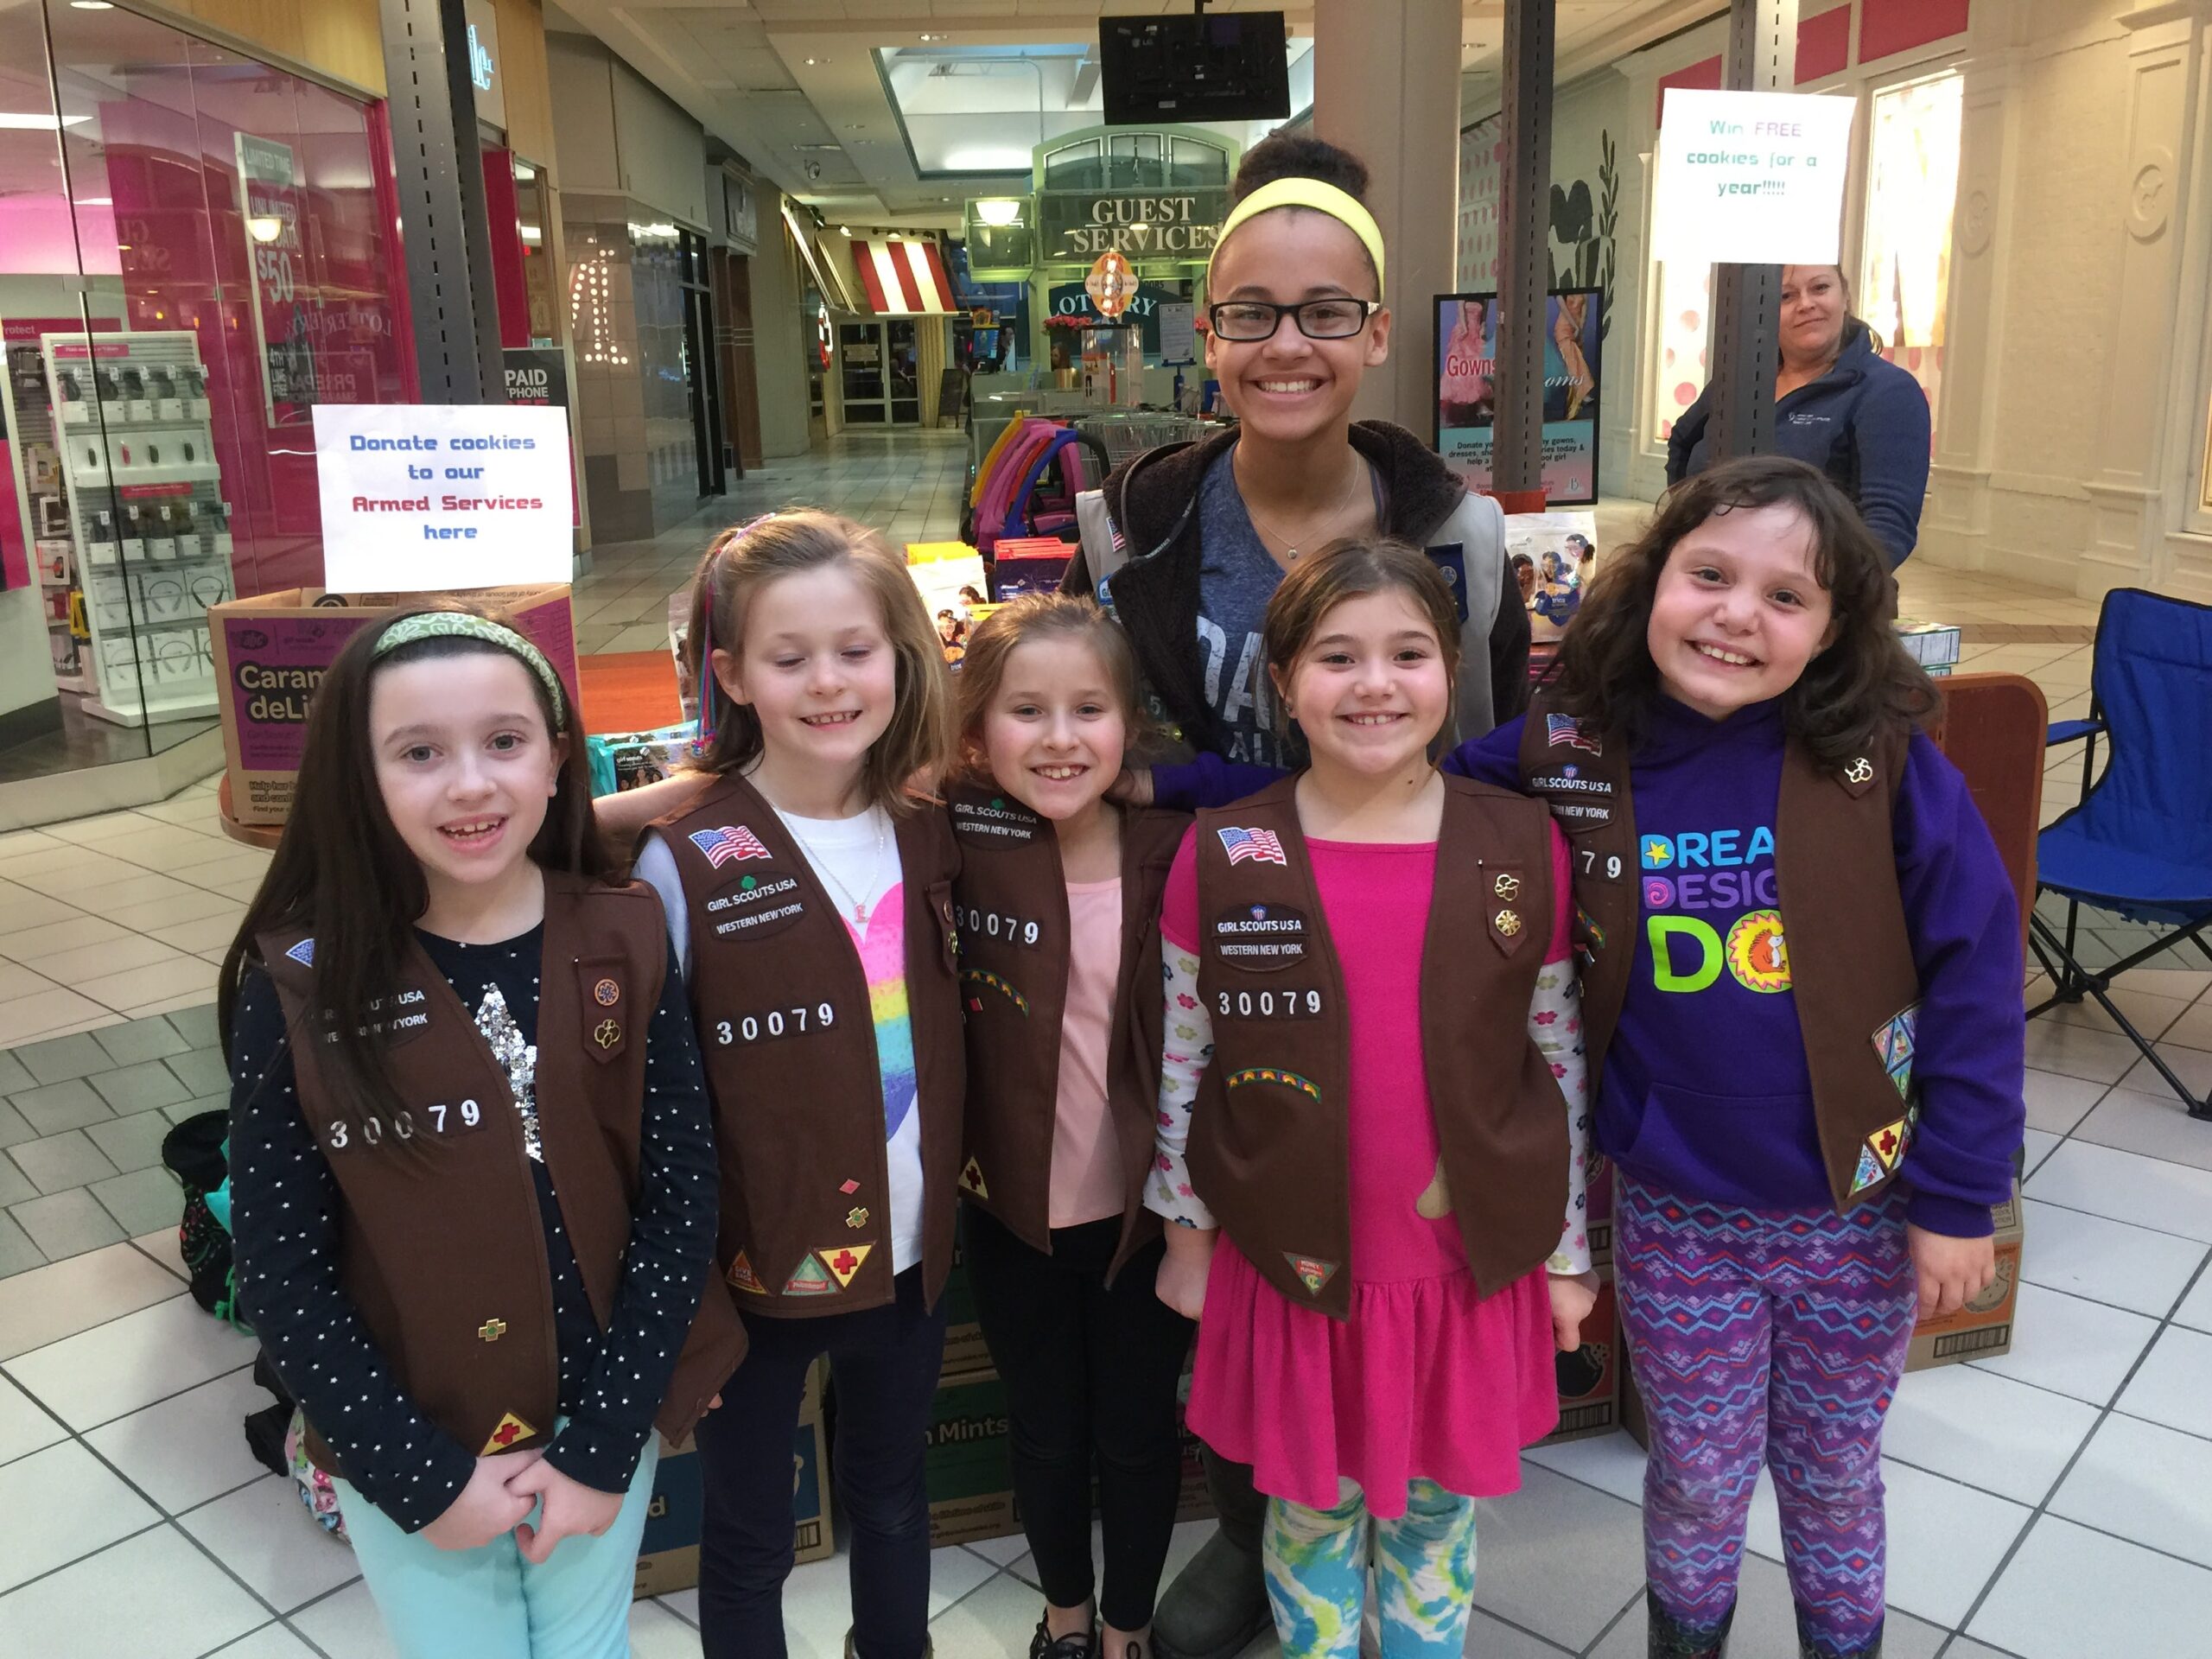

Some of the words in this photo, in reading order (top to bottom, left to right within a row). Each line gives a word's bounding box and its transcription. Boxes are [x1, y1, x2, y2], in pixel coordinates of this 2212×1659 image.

[1710, 120, 1744, 135] Win
[1755, 122, 1802, 137] FREE
[245, 148, 275, 169] LIMITED
[275, 156, 291, 174] TIME
[1687, 150, 1759, 165] cookies
[1770, 152, 1796, 168] for
[1806, 156, 1817, 167] a
[1718, 180, 1785, 197] year!!!!!
[251, 196, 296, 222] UNLIMITED
[1091, 197, 1195, 225] GUEST
[1074, 226, 1218, 253] SERVICES
[257, 250, 294, 303] $50
[1054, 294, 1157, 317] OTRY
[4, 325, 36, 335] rotect
[270, 347, 284, 366] 4TH
[504, 369, 548, 386] PAID
[1544, 376, 1584, 387] oms
[506, 387, 549, 398] PHONE
[350, 435, 438, 451] Donate
[449, 435, 536, 450] cookies
[1556, 445, 1576, 454] today
[1467, 458, 1483, 467] help
[408, 464, 433, 480] to
[445, 467, 485, 480] our
[353, 496, 430, 512] Armed
[442, 495, 543, 511] Services
[423, 524, 478, 540] here
[250, 695, 309, 720] deLi
[249, 781, 270, 791] Help
[1548, 778, 1587, 790] SCOUTS
[1589, 781, 1611, 793] USA
[955, 804, 975, 814] GIRL
[976, 806, 1016, 821] SCOUTS
[1018, 815, 1037, 824] USA
[1565, 805, 1586, 817] NEW
[1586, 807, 1610, 819] YORK
[957, 822, 989, 834] WESTERN
[990, 825, 1010, 836] NEW
[1010, 828, 1032, 839] YORK
[1640, 826, 1776, 870] DREA
[708, 897, 733, 912] GIRL
[733, 884, 775, 906] SCOUTS
[776, 878, 798, 893] USA
[1643, 868, 1779, 910] DESIG
[716, 916, 759, 935] WESTERN
[759, 910, 779, 924] NEW
[779, 903, 804, 917] YORK
[956, 906, 1039, 944] 30079
[1217, 922, 1240, 933] GIRL
[1239, 920, 1279, 931] SCOUTS
[1280, 919, 1301, 931] USA
[1220, 944, 1259, 956] WESTERN
[1260, 944, 1279, 956] NEW
[1280, 944, 1303, 955] YORK
[397, 990, 425, 1004] USA
[1218, 990, 1320, 1016] 30079
[399, 1013, 428, 1028] YORK
[716, 1002, 834, 1046] 30079
[939, 1417, 1008, 1444] Mints
